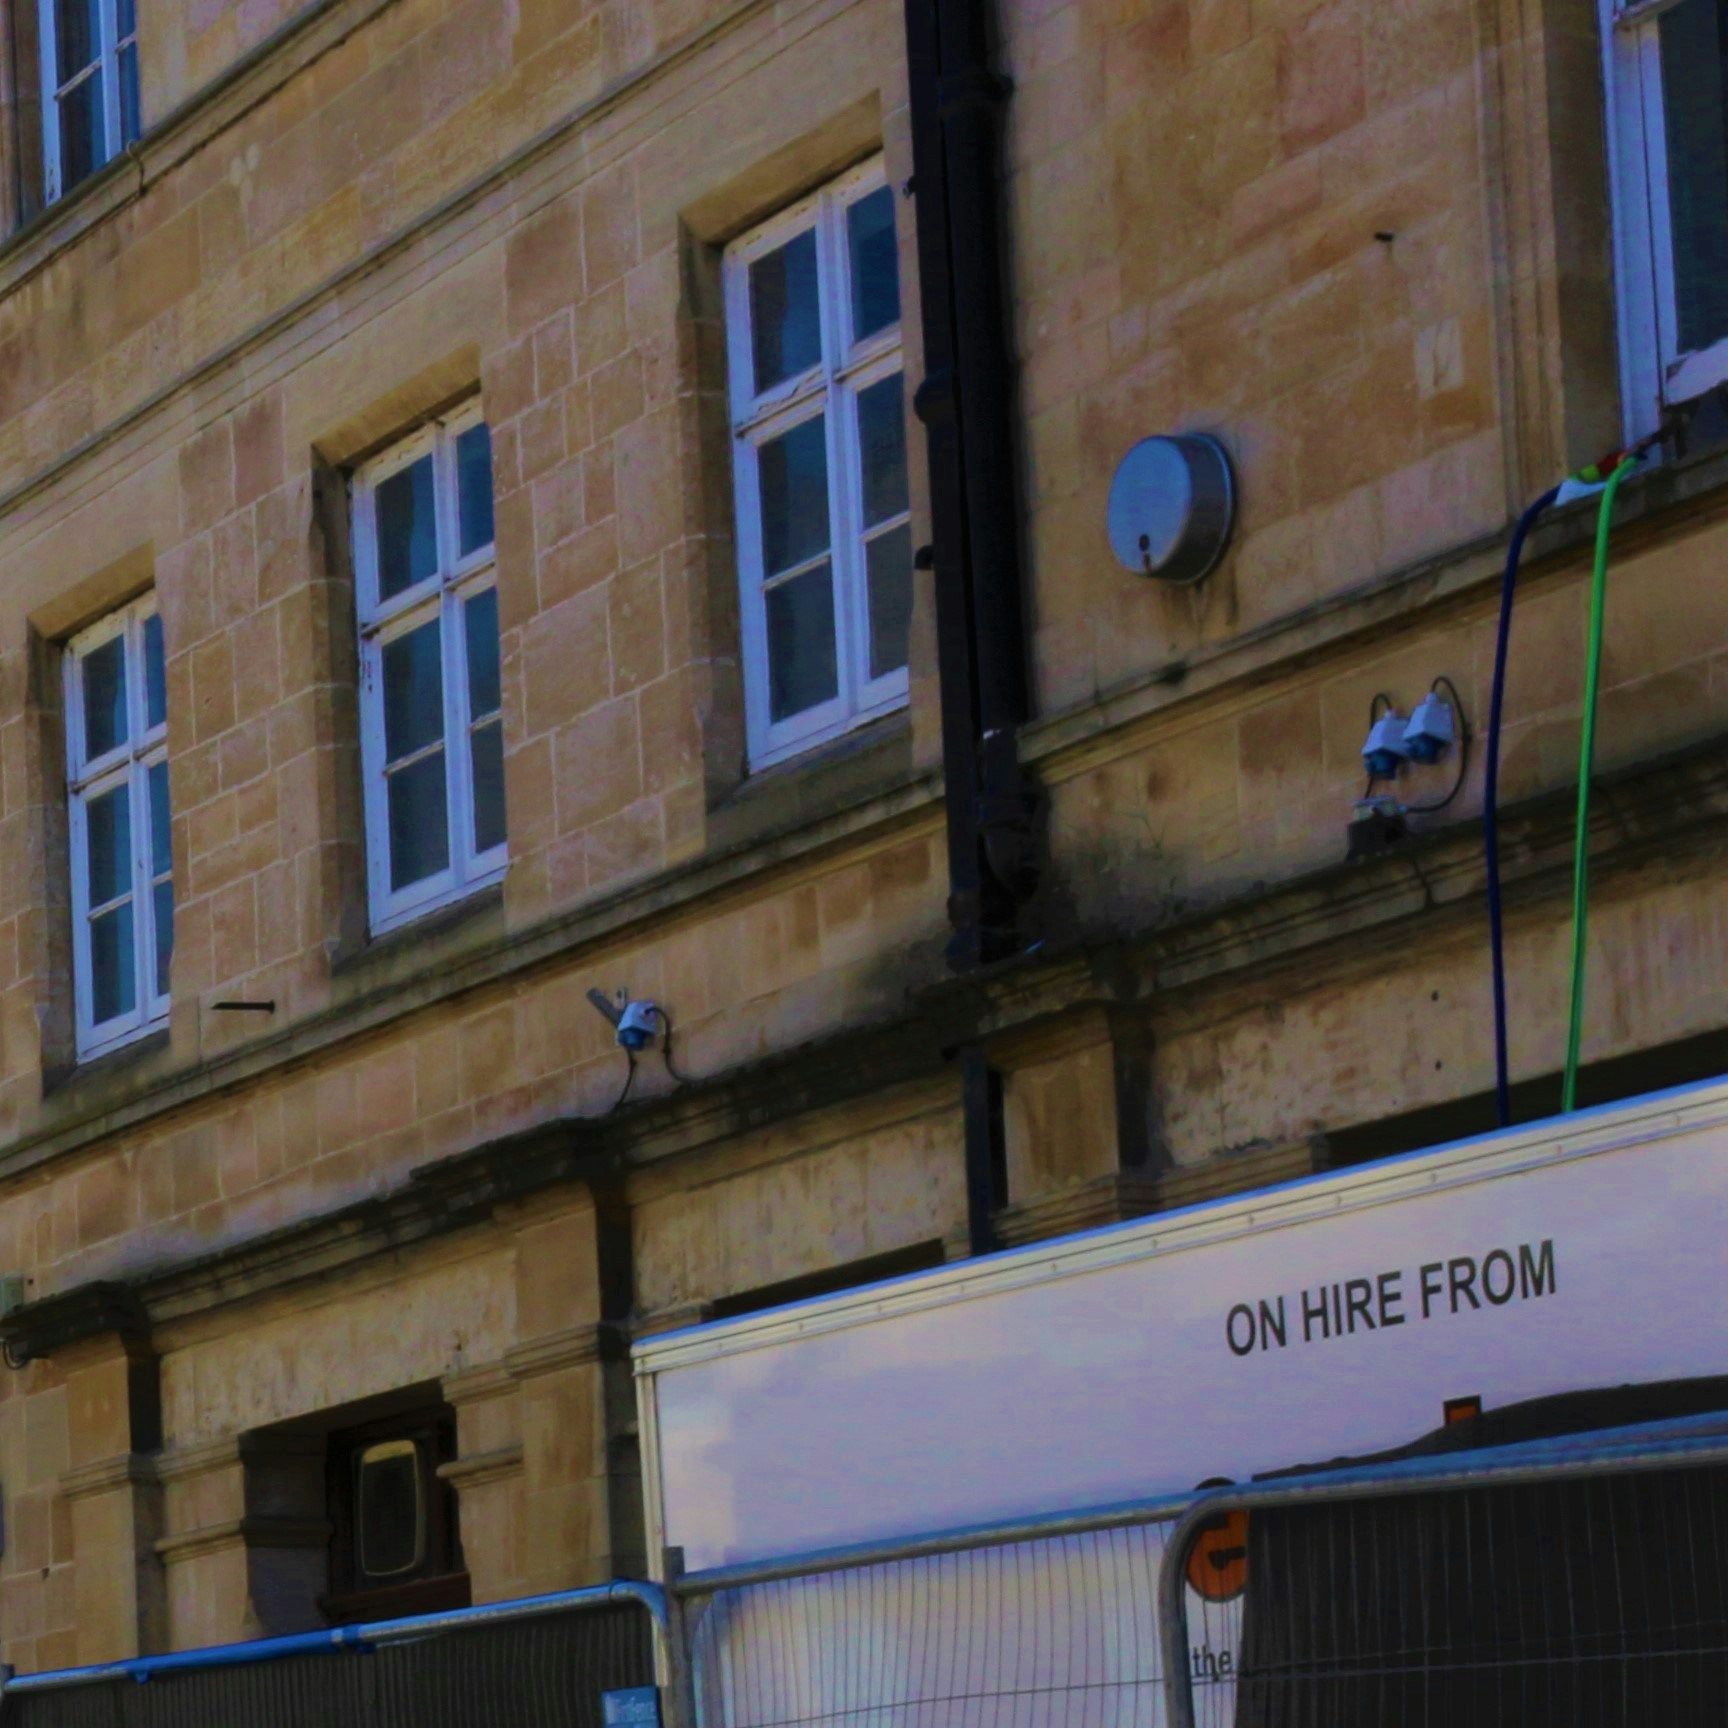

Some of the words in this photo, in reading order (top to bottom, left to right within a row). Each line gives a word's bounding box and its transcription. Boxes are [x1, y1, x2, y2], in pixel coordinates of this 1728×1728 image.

[1226, 1296, 1287, 1356] ON
[1301, 1270, 1405, 1342] HIRE
[1419, 1239, 1557, 1319] FROM
[1192, 1644, 1232, 1678] the
